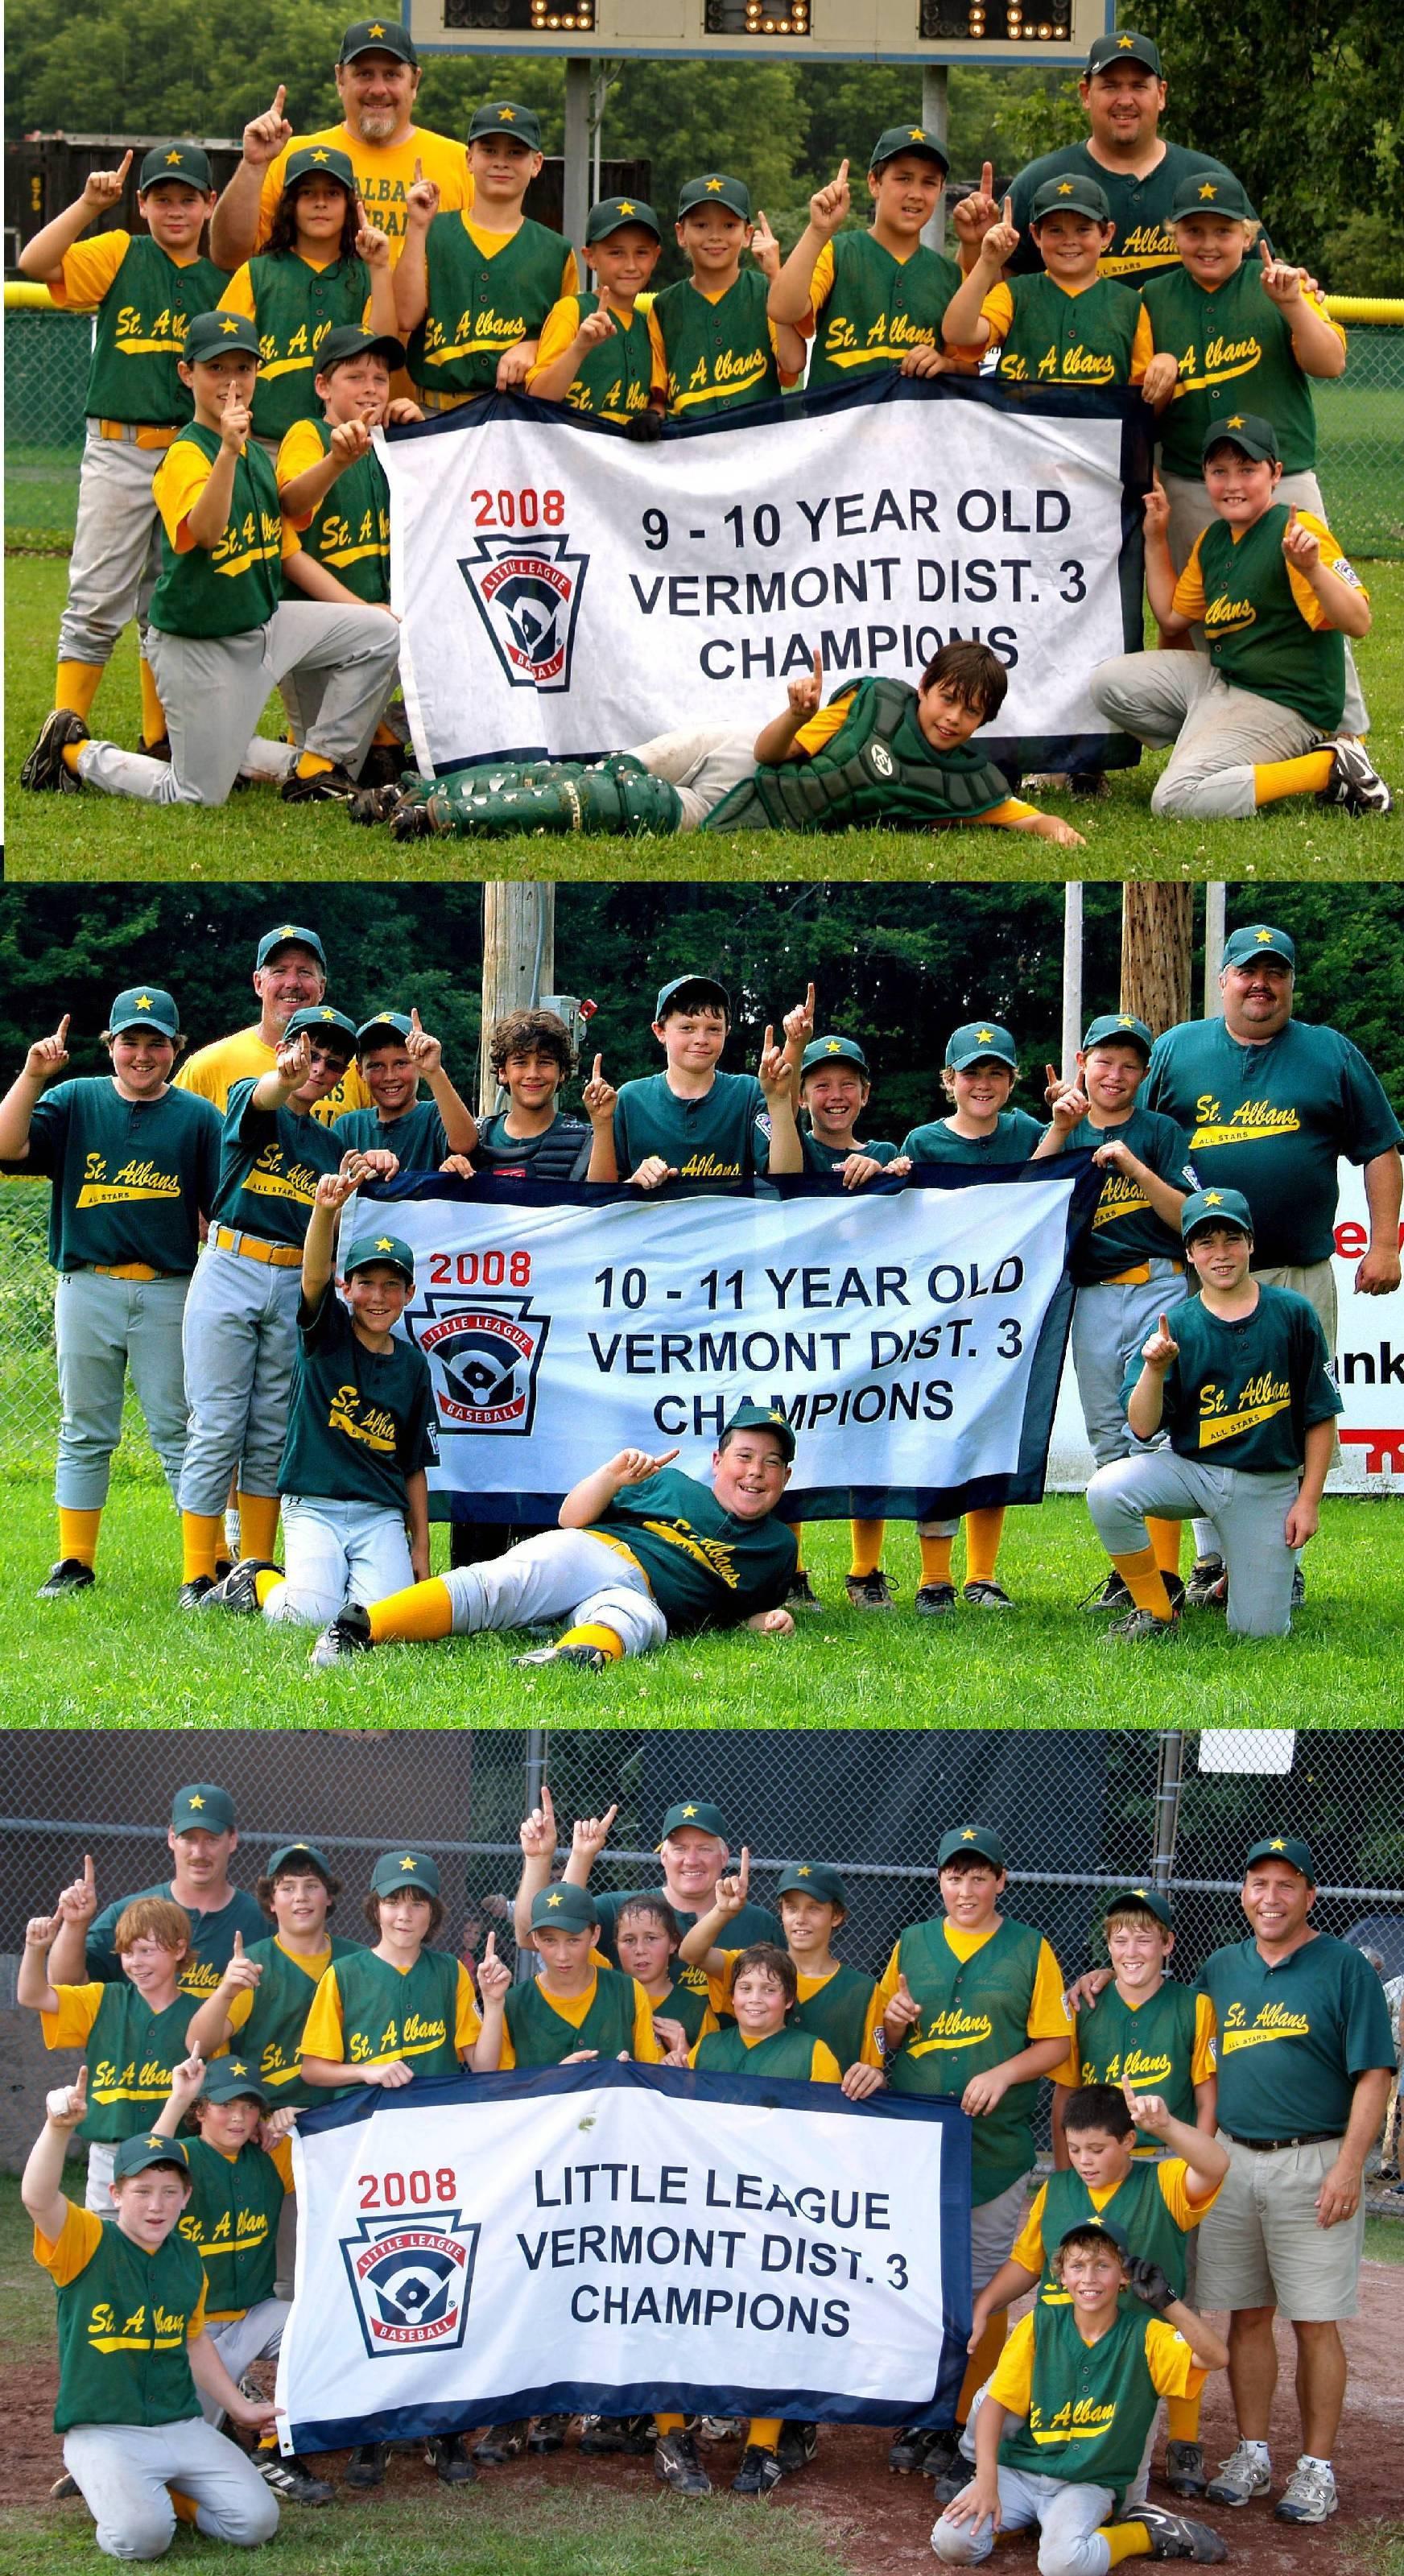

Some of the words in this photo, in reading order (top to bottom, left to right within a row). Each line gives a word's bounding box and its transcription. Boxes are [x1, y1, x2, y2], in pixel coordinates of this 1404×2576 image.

[353, 177, 414, 201] ALBA
[1111, 262, 1141, 273] STARS
[115, 306, 142, 336] St.
[424, 318, 447, 351] St.
[454, 308, 526, 345] Albans
[824, 316, 857, 350] St.
[866, 312, 935, 347] Albans
[688, 347, 767, 390] Albans
[1000, 353, 1029, 381] St.
[1037, 344, 1115, 378] Albans
[1179, 336, 1262, 375] Albans
[565, 380, 594, 411] St.
[470, 489, 565, 527] 2008
[642, 508, 669, 551] 9
[724, 503, 781, 548] 10
[795, 488, 941, 543] YEAR
[956, 489, 1072, 533] OLD
[212, 523, 242, 560] St.
[319, 514, 352, 550] St.
[520, 560, 568, 590] LEAGUE
[628, 557, 901, 617] VERMONT
[917, 559, 1039, 603] DIST.
[1059, 559, 1087, 603] 3
[1195, 1095, 1221, 1123] St.
[1229, 1099, 1300, 1127] Albans
[1198, 1137, 1216, 1146] ALL
[1218, 1132, 1249, 1141] STARS
[84, 1152, 108, 1180] St.
[113, 1159, 181, 1191] Albans
[256, 1143, 284, 1172] St.
[101, 1191, 130, 1201] STARS
[252, 1183, 269, 1192] ALL
[1092, 1209, 1117, 1226] TARS
[429, 1250, 532, 1287] 2008
[595, 1267, 646, 1310] 10
[700, 1269, 744, 1310] 11
[764, 1265, 911, 1310] YEAR
[927, 1256, 1024, 1303] OLD
[423, 1316, 469, 1345] LITTLE
[475, 1316, 531, 1349] LEAGUE
[587, 1331, 851, 1374] VERMONT
[870, 1318, 977, 1371] DIST.
[997, 1318, 1022, 1359] 3
[446, 1403, 519, 1422] BASEBALL
[653, 1379, 954, 1436] CHMPIONS
[1199, 1384, 1228, 1415] St.
[1210, 1429, 1228, 1441] ALL
[1229, 1413, 1261, 1434] STARS
[927, 2007, 992, 2039] Albans
[1224, 2002, 1246, 2028] St.
[1252, 2001, 1309, 2031] Albans
[349, 2033, 374, 2062] St.
[380, 2013, 447, 2052] Albans
[1242, 2033, 1268, 2046] STARS
[92, 2060, 117, 2088] St.
[260, 2043, 287, 2073] St.
[1105, 2049, 1171, 2083] Albans
[357, 2167, 456, 2210] 2008
[535, 2163, 689, 2208] LITTLE
[705, 2169, 891, 2231] LEAGUE
[177, 2215, 205, 2243] St.
[359, 2237, 404, 2269] LITTLE
[410, 2235, 462, 2259] LEAGUE
[516, 2224, 747, 2272] VERMONT
[761, 2233, 874, 2285] DIST.
[886, 2253, 910, 2291] 3
[87, 2303, 116, 2334] St.
[570, 2284, 851, 2339] CHAMPIONS
[378, 2319, 452, 2342] BASEBALL
